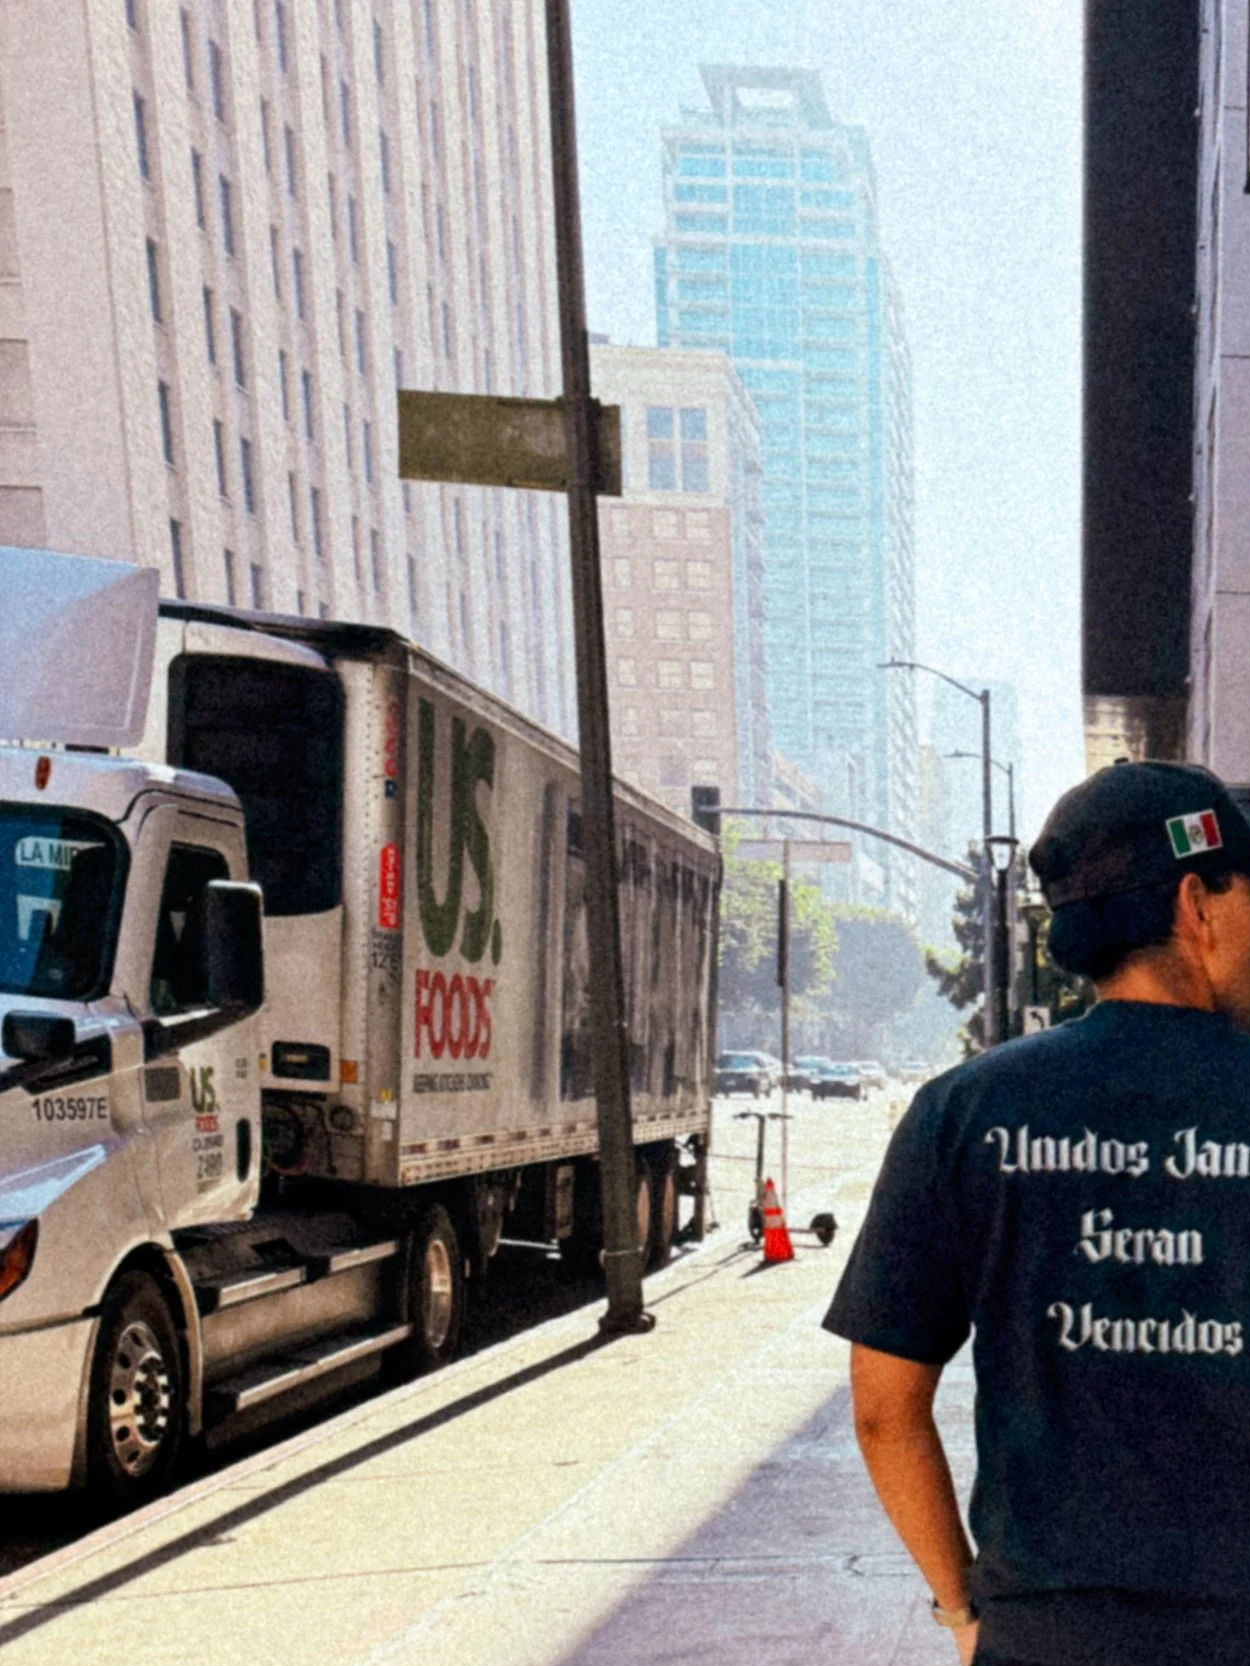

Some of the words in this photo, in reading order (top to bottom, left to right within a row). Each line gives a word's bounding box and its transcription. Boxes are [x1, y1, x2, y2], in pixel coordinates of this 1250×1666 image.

[20, 841, 44, 864] LA
[414, 968, 494, 1060] FOODS
[31, 1096, 108, 1121] 103597E
[984, 1123, 1150, 1178] Unidos
[1074, 1206, 1205, 1267] Seran
[1046, 1301, 1245, 1357] Vencidos
